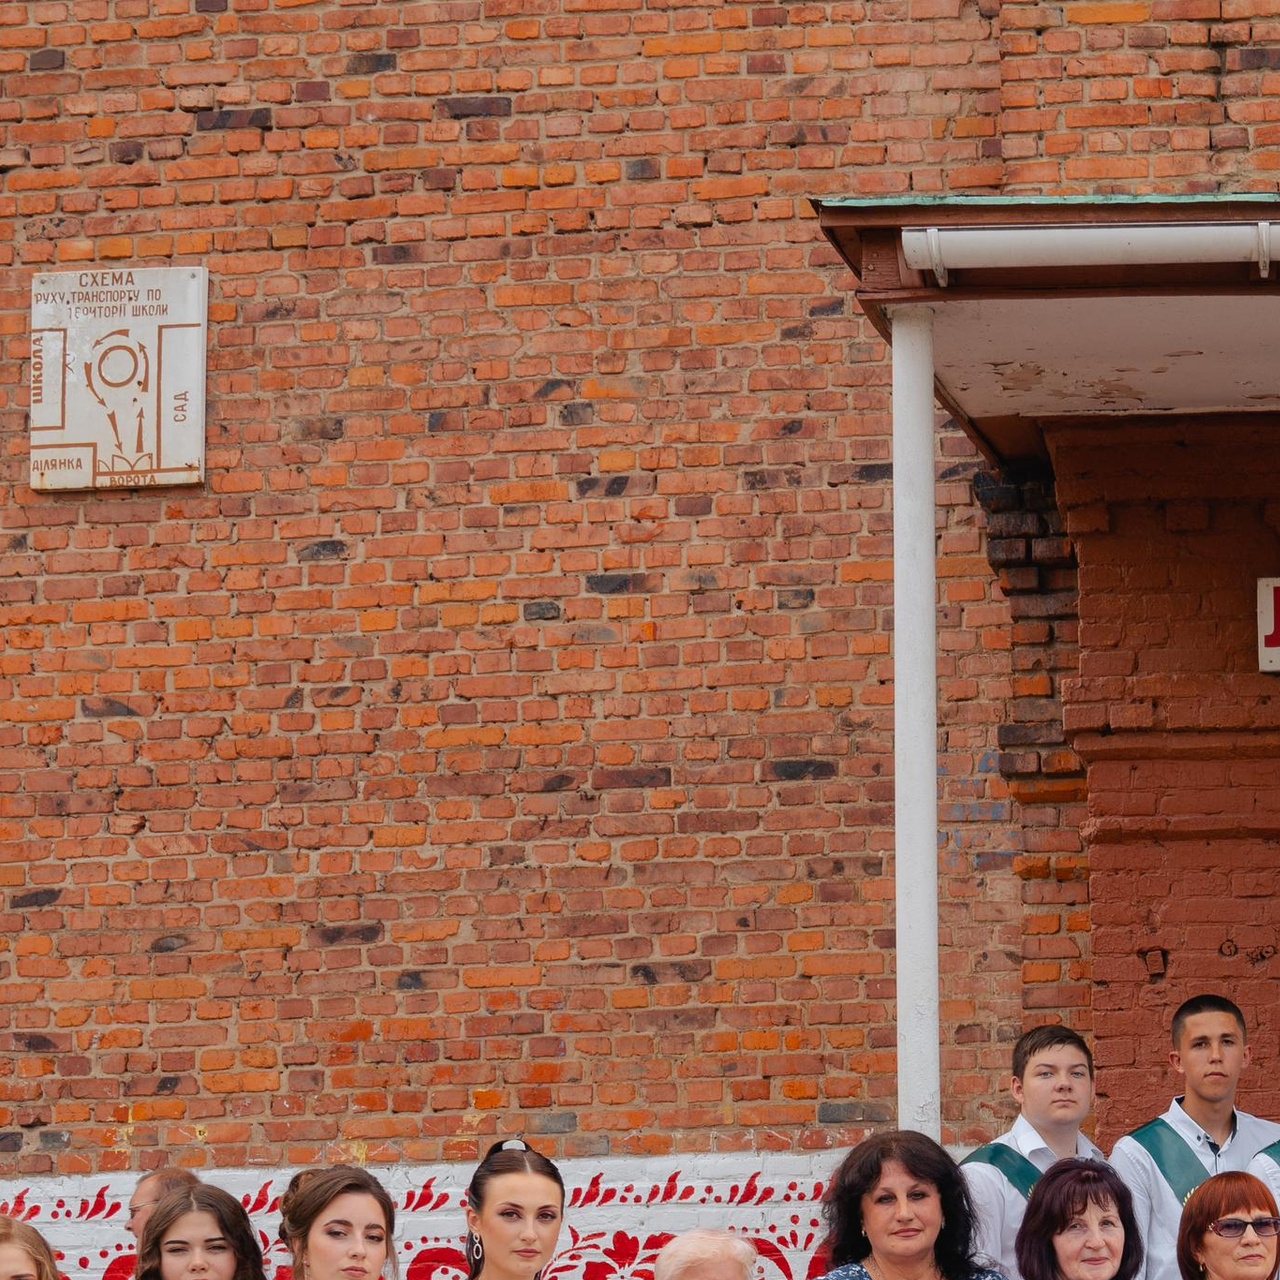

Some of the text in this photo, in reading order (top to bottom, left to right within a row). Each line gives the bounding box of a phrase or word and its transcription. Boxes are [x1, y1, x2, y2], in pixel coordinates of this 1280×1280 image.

[79, 271, 135, 287] СХЕМА
[35, 289, 162, 304] РУХУ ТРАНСПОРТУ ПО
[132, 304, 169, 317] ШКОЛИ
[32, 335, 44, 404] ШКОЛА
[173, 391, 189, 423] САД
[32, 458, 83, 471] ДІЛЯНКА
[110, 474, 157, 486] ВОРОТА
